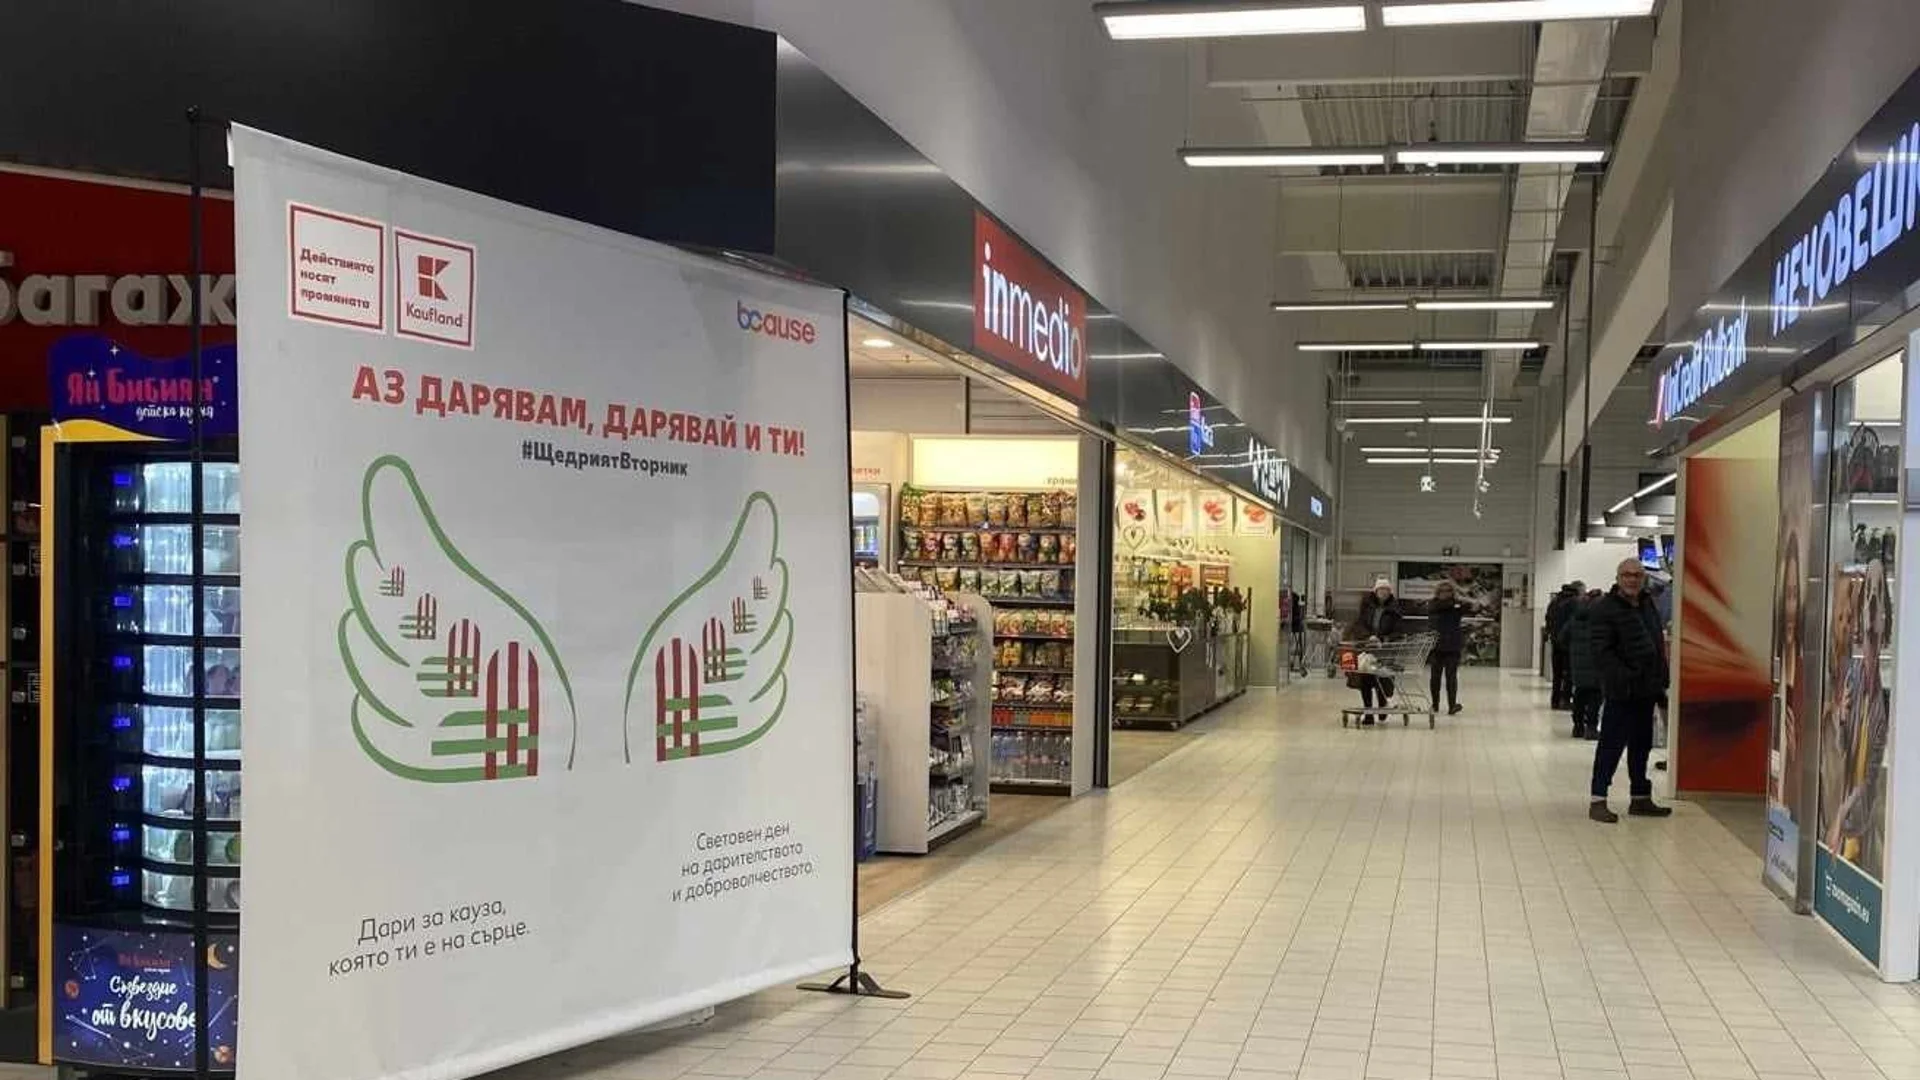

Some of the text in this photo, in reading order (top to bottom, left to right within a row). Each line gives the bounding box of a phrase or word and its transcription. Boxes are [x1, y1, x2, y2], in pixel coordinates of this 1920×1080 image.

[300, 248, 375, 274] Действията
[300, 270, 337, 285] носят
[300, 287, 370, 309] промяната
[982, 241, 1082, 380] inmedio
[406, 302, 463, 328] Kaufland
[352, 366, 805, 457] АЗ ДАРЯВАМ, ДАРЯВАЙ И ТИ!
[522, 440, 688, 477] #ЩедриятВторник
[696, 821, 790, 851] Световен ден
[682, 842, 803, 877] на дарителството
[672, 887, 682, 902] и
[358, 900, 506, 945] Дари за кауза,
[329, 921, 531, 976] която ти е на сърце.
[109, 975, 178, 1002] Съзвездие
